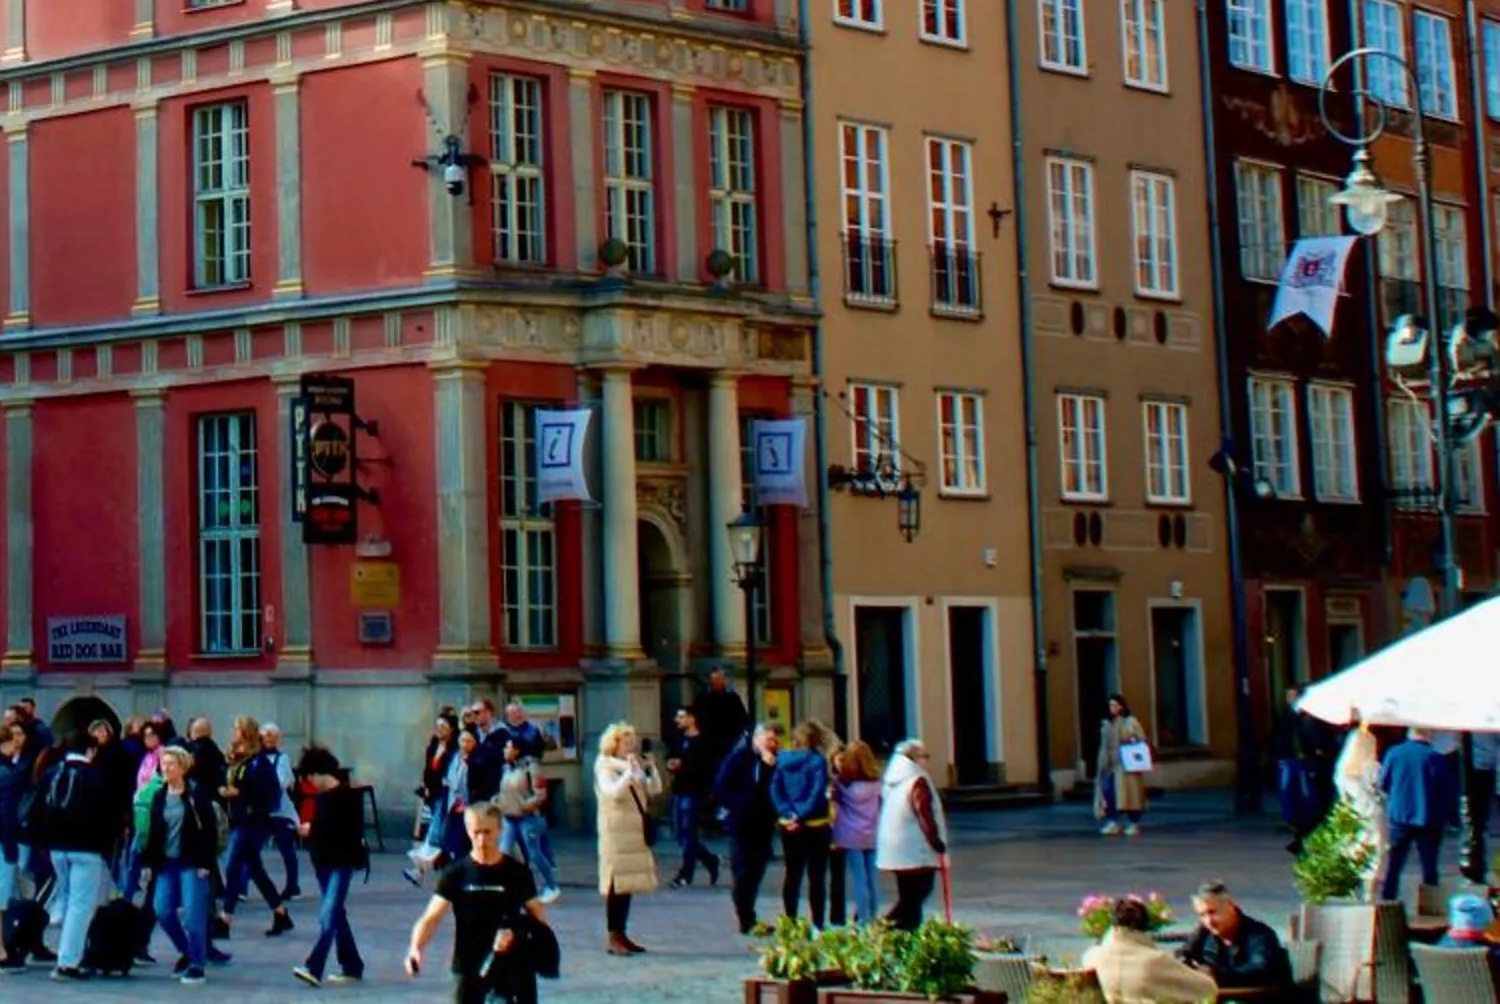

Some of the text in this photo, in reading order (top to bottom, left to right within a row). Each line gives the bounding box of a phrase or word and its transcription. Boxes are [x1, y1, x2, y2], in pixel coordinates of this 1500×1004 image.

[52, 624, 68, 639] THE
[52, 643, 123, 659] RED DOG BAR
